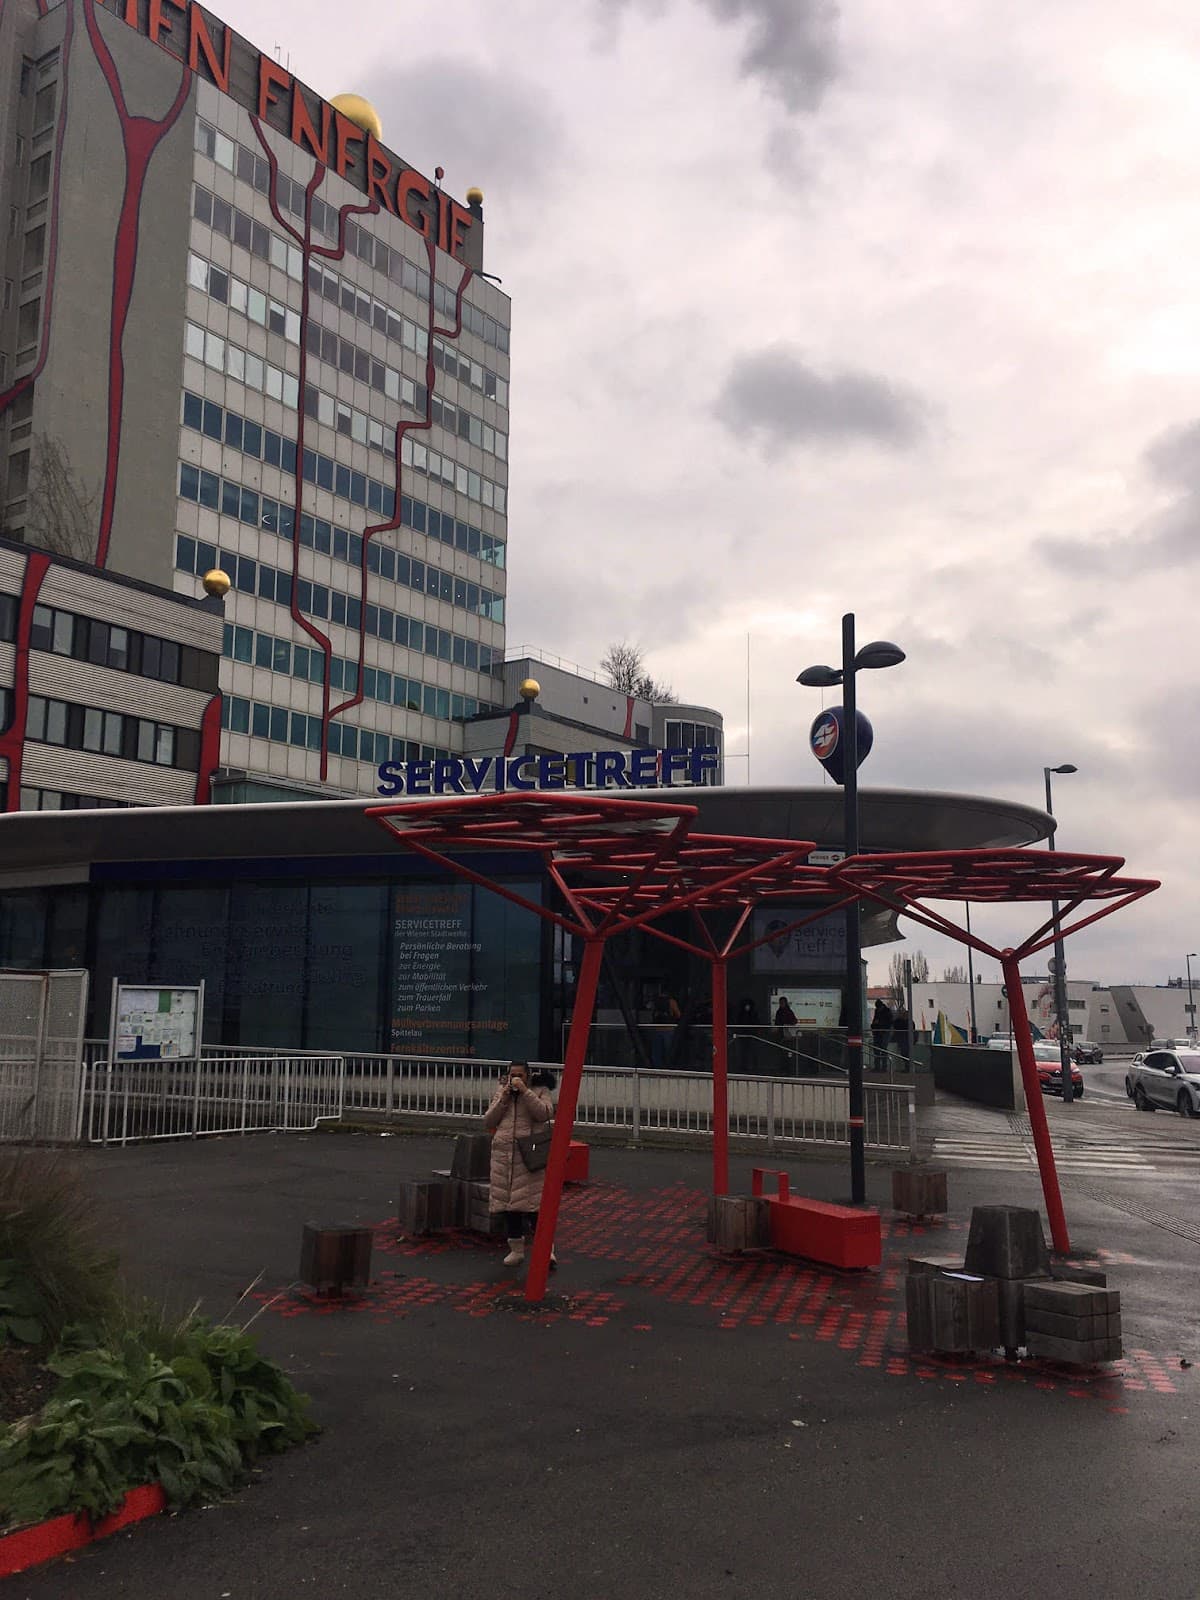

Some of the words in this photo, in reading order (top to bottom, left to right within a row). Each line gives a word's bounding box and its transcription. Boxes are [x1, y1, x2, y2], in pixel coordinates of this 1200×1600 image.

[257, 54, 472, 259] ENERGIE
[377, 744, 719, 795] SERVICETREFF
[394, 919, 463, 929] SERVICETREFF
[399, 942, 445, 950] Persönliche
[446, 943, 482, 952] Beratung
[400, 951, 412, 959] bei
[413, 952, 439, 961] Fragen
[414, 993, 451, 1002] Trauerfall
[415, 1003, 441, 1011] Parken
[391, 1029, 422, 1038] Spittelau
